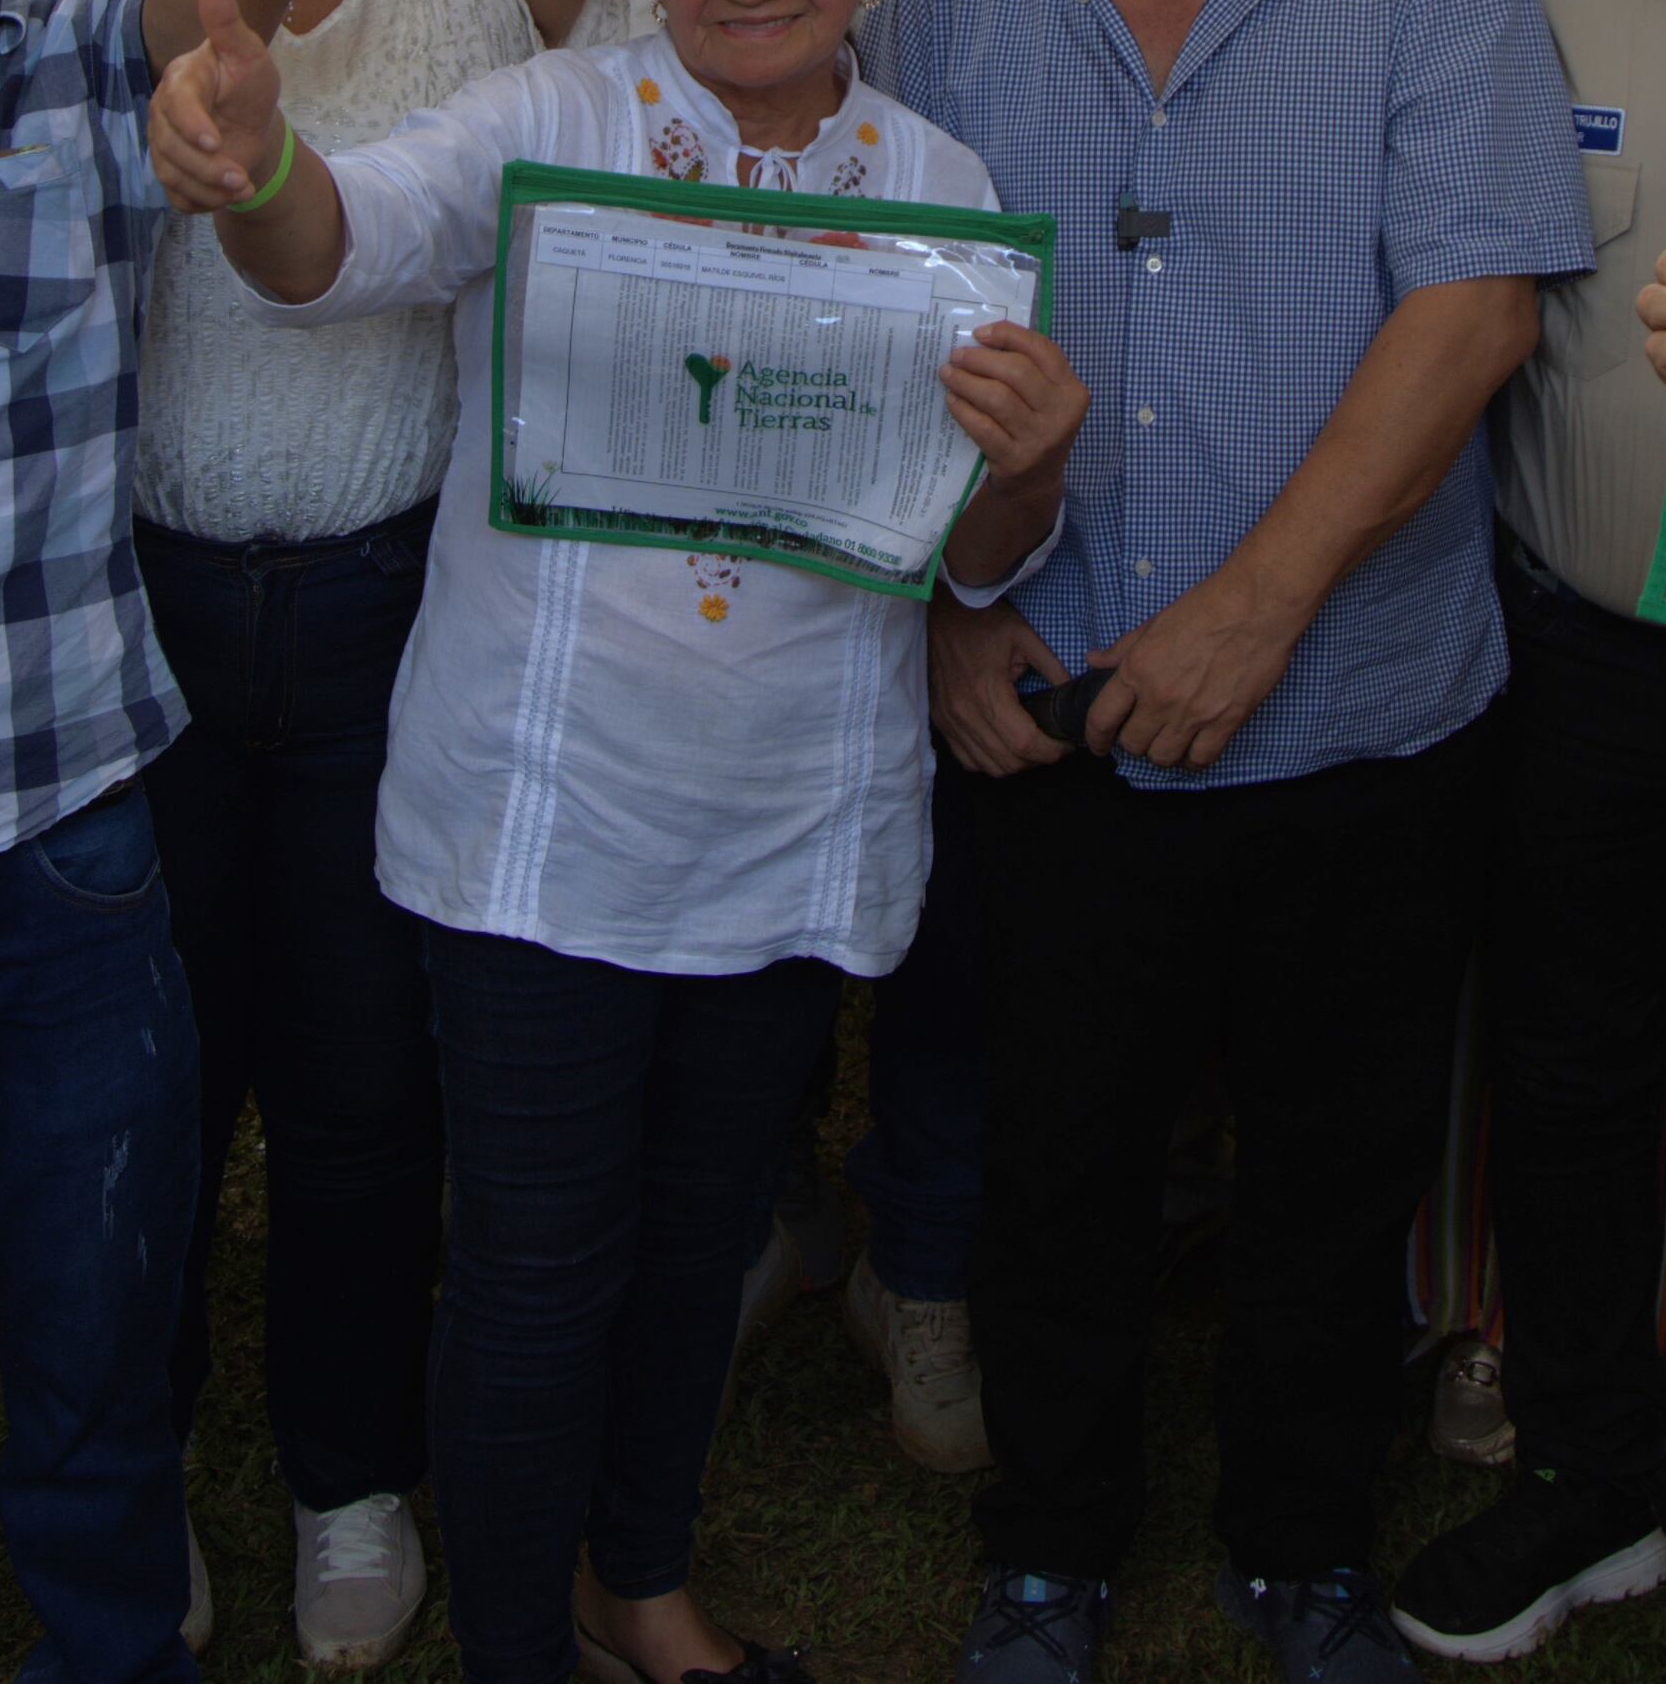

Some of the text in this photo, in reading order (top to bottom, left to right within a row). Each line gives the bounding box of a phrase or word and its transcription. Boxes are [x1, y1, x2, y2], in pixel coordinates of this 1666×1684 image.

[543, 225, 901, 279] DEPARTAMENTO MUNICIPIO CÉDULA NOMBRE CÉDULA NOMBRE
[607, 252, 647, 266] FLORENCIA
[701, 265, 730, 277] MATILDE
[732, 268, 768, 282] ESQUIVEL
[737, 360, 848, 390] Agencia
[734, 384, 877, 415] Nacional de
[735, 408, 831, 432] Tierras
[844, 537, 855, 552] 01
